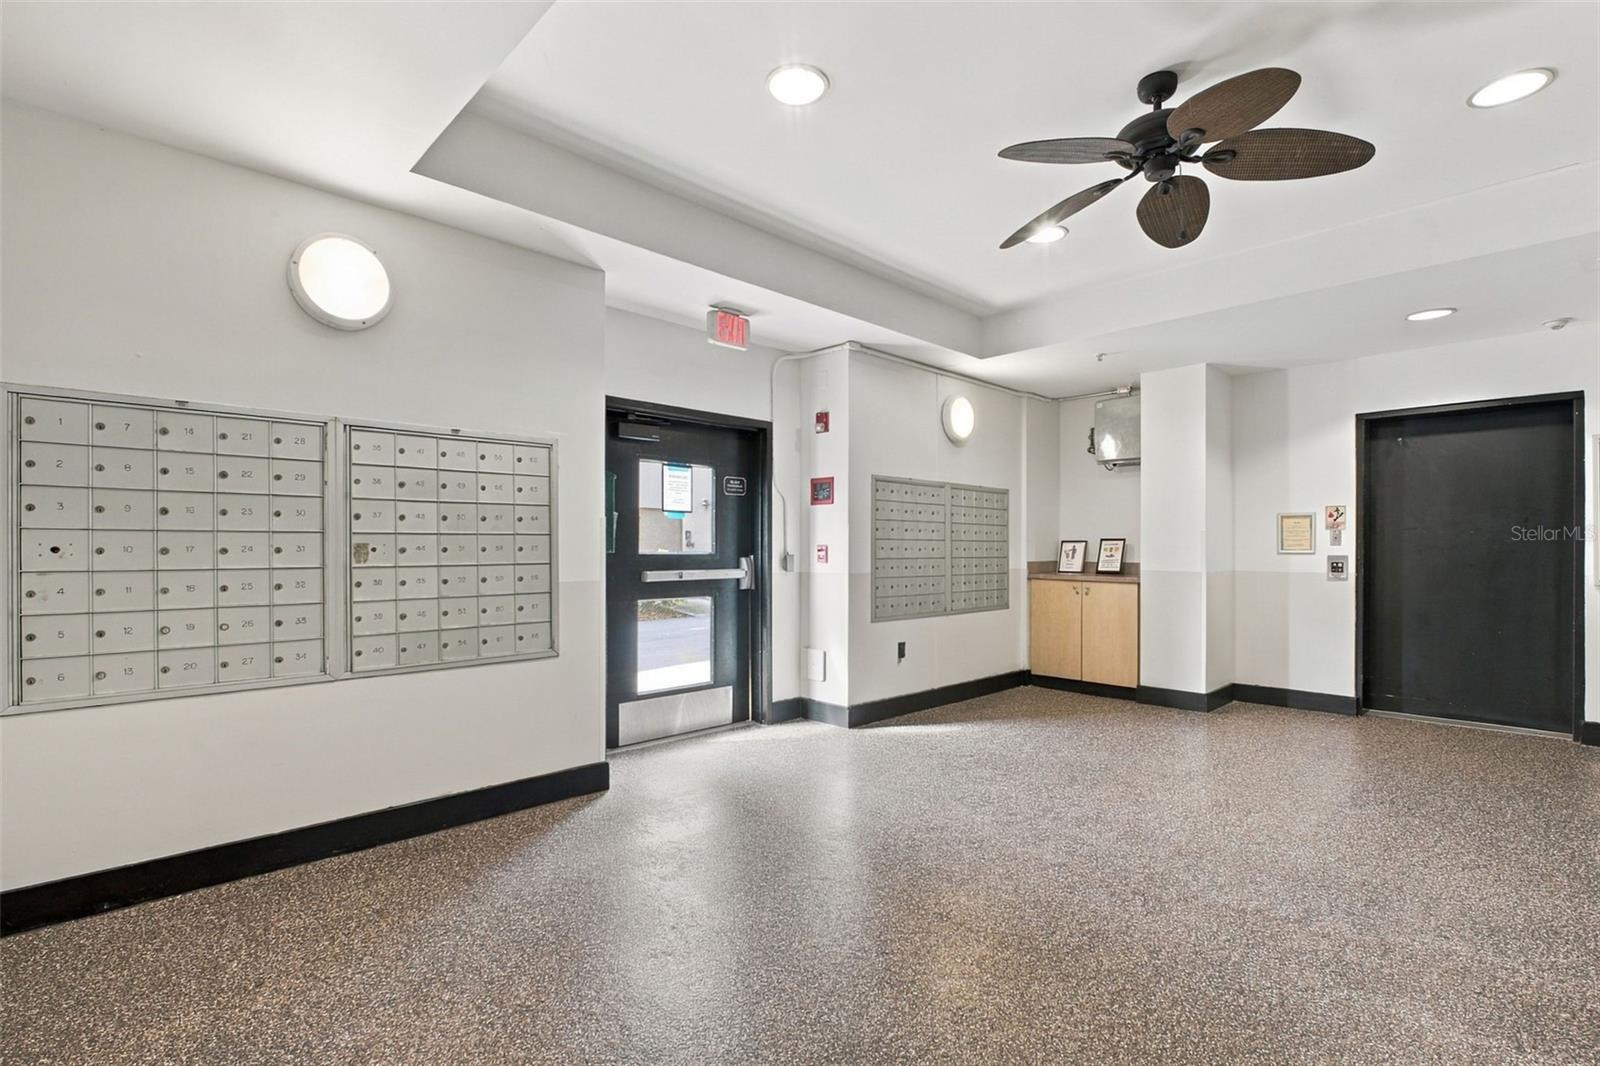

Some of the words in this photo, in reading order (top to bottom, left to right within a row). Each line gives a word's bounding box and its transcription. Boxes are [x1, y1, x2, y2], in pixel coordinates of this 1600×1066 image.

[58, 417, 63, 426] 1
[124, 422, 131, 431] 7
[241, 432, 252, 441] 21
[293, 436, 306, 445] 28
[55, 459, 64, 469] 2
[123, 463, 132, 472] 8
[184, 466, 195, 476] 15
[240, 470, 253, 479] 22
[294, 473, 306, 482] 29
[56, 501, 65, 511] 3
[123, 504, 132, 513] 9
[240, 507, 254, 516] 23
[295, 508, 306, 517] 30
[122, 545, 134, 554] 10
[185, 545, 195, 553] 17
[240, 545, 254, 553] 24
[295, 544, 306, 553] 31
[240, 582, 254, 591] 25
[294, 580, 306, 589] 32
[56, 587, 65, 595] 4
[124, 585, 133, 595] 11
[185, 623, 196, 631] 19
[241, 619, 255, 628] 26
[57, 630, 65, 639] 5
[123, 626, 133, 635] 12
[372, 646, 385, 654] 40
[294, 651, 308, 661] 34
[241, 656, 255, 666] 27
[123, 667, 134, 676] 13
[183, 662, 198, 672] 20
[56, 672, 65, 682] 6
